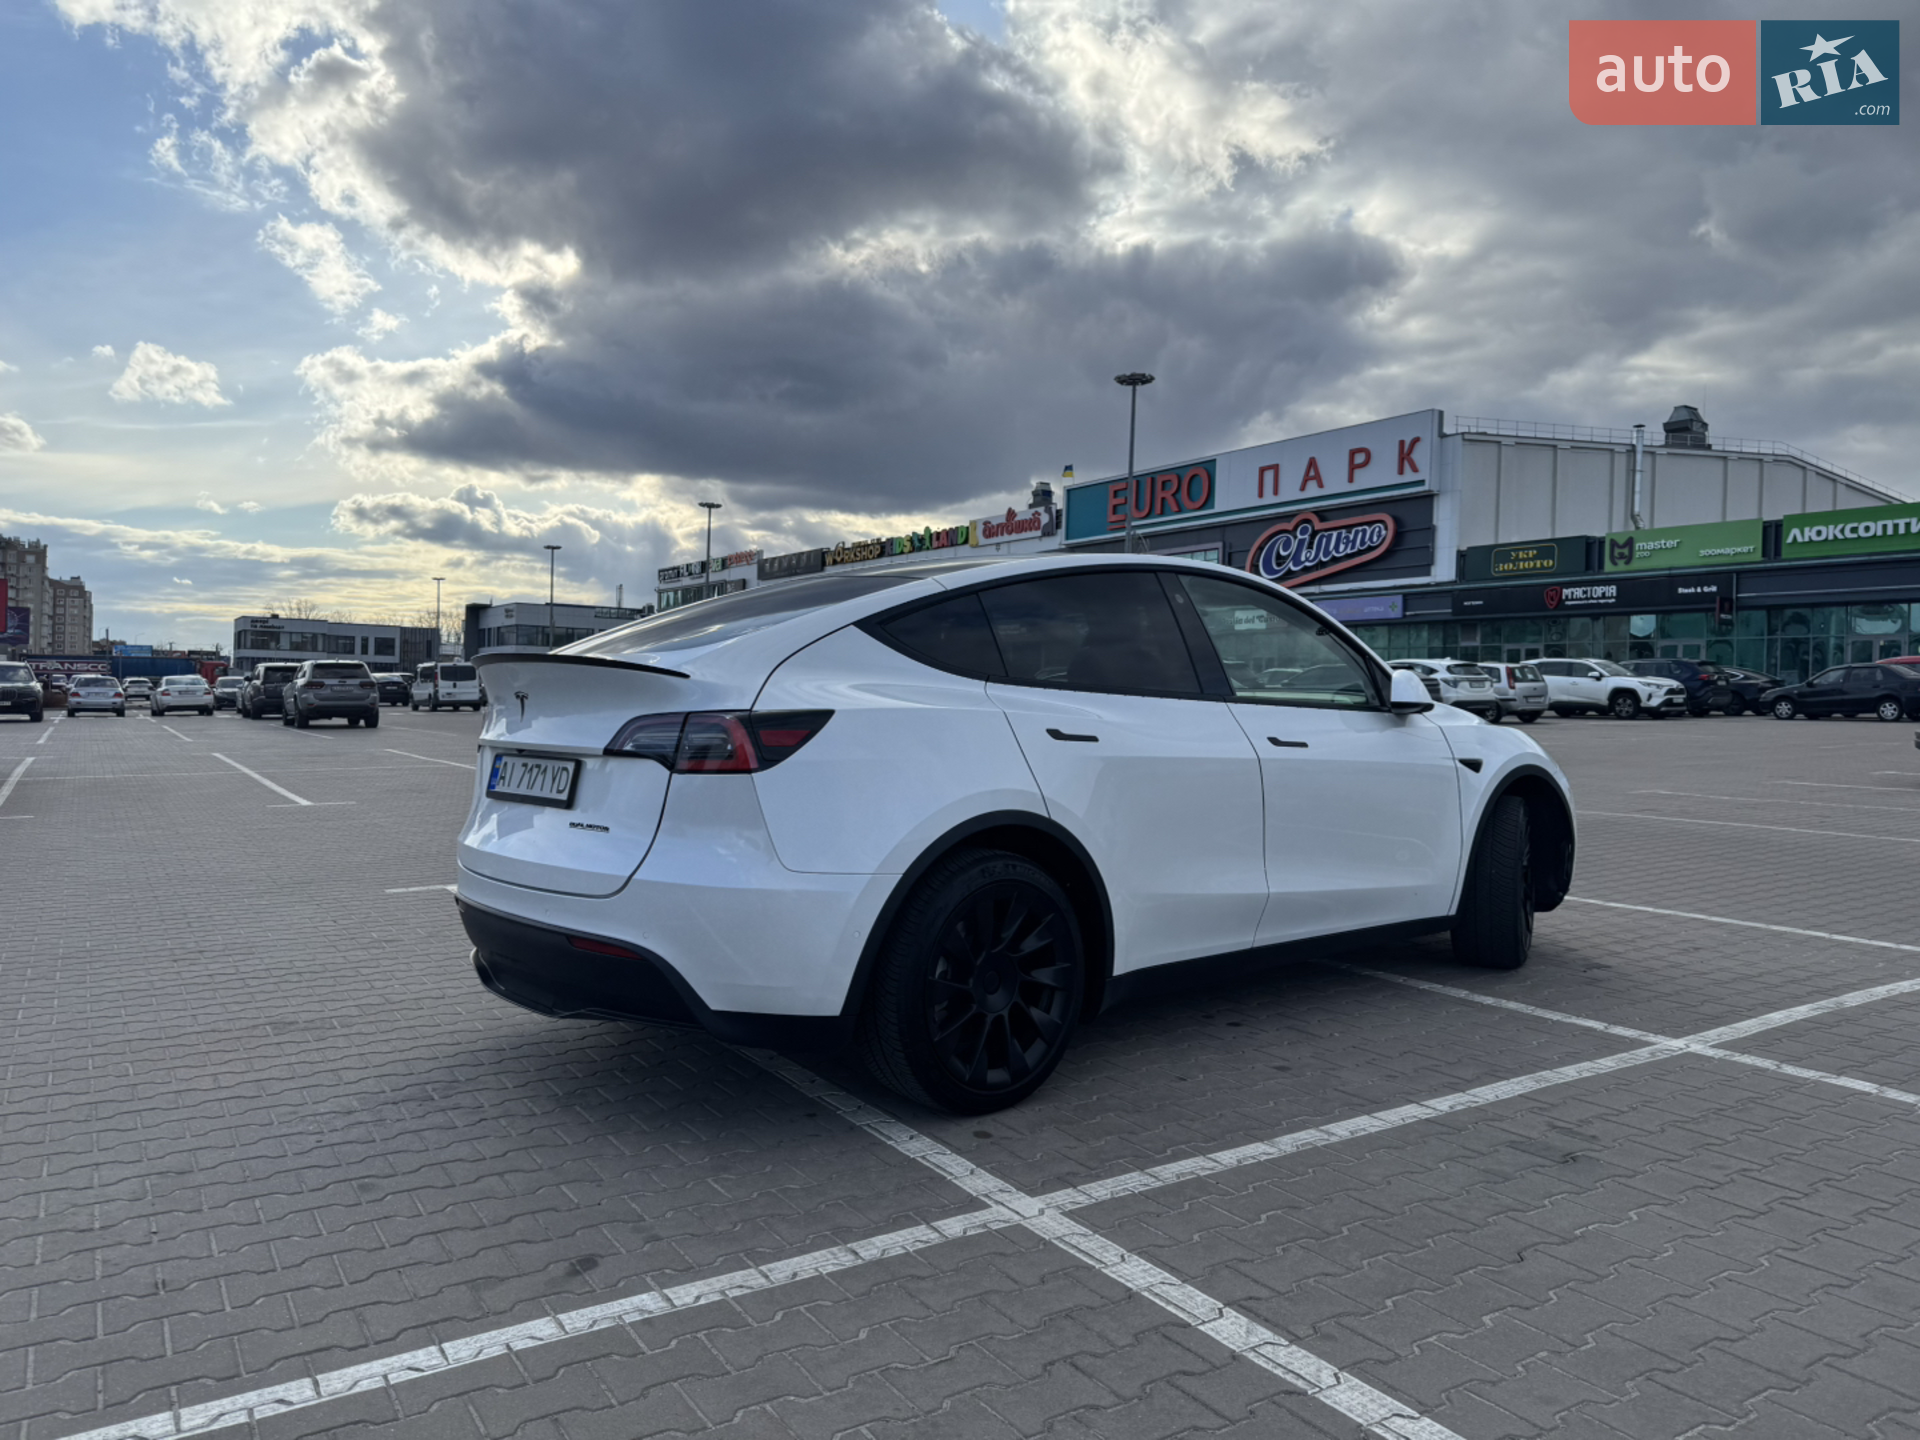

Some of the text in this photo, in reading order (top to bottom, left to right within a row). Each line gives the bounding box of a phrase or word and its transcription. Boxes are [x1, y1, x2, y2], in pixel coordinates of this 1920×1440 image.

[1107, 437, 1421, 524] EURO ПАРК
[932, 526, 967, 549] LAND
[1636, 539, 1680, 551] master
[825, 542, 881, 566] WORKSHOP
[1259, 523, 1387, 579] Сільпо
[1510, 549, 1537, 559] УКР
[1699, 545, 1755, 557] зоомаркет
[1495, 559, 1553, 571] ЗОЛОТО
[496, 761, 570, 794] AI 7171 YD
